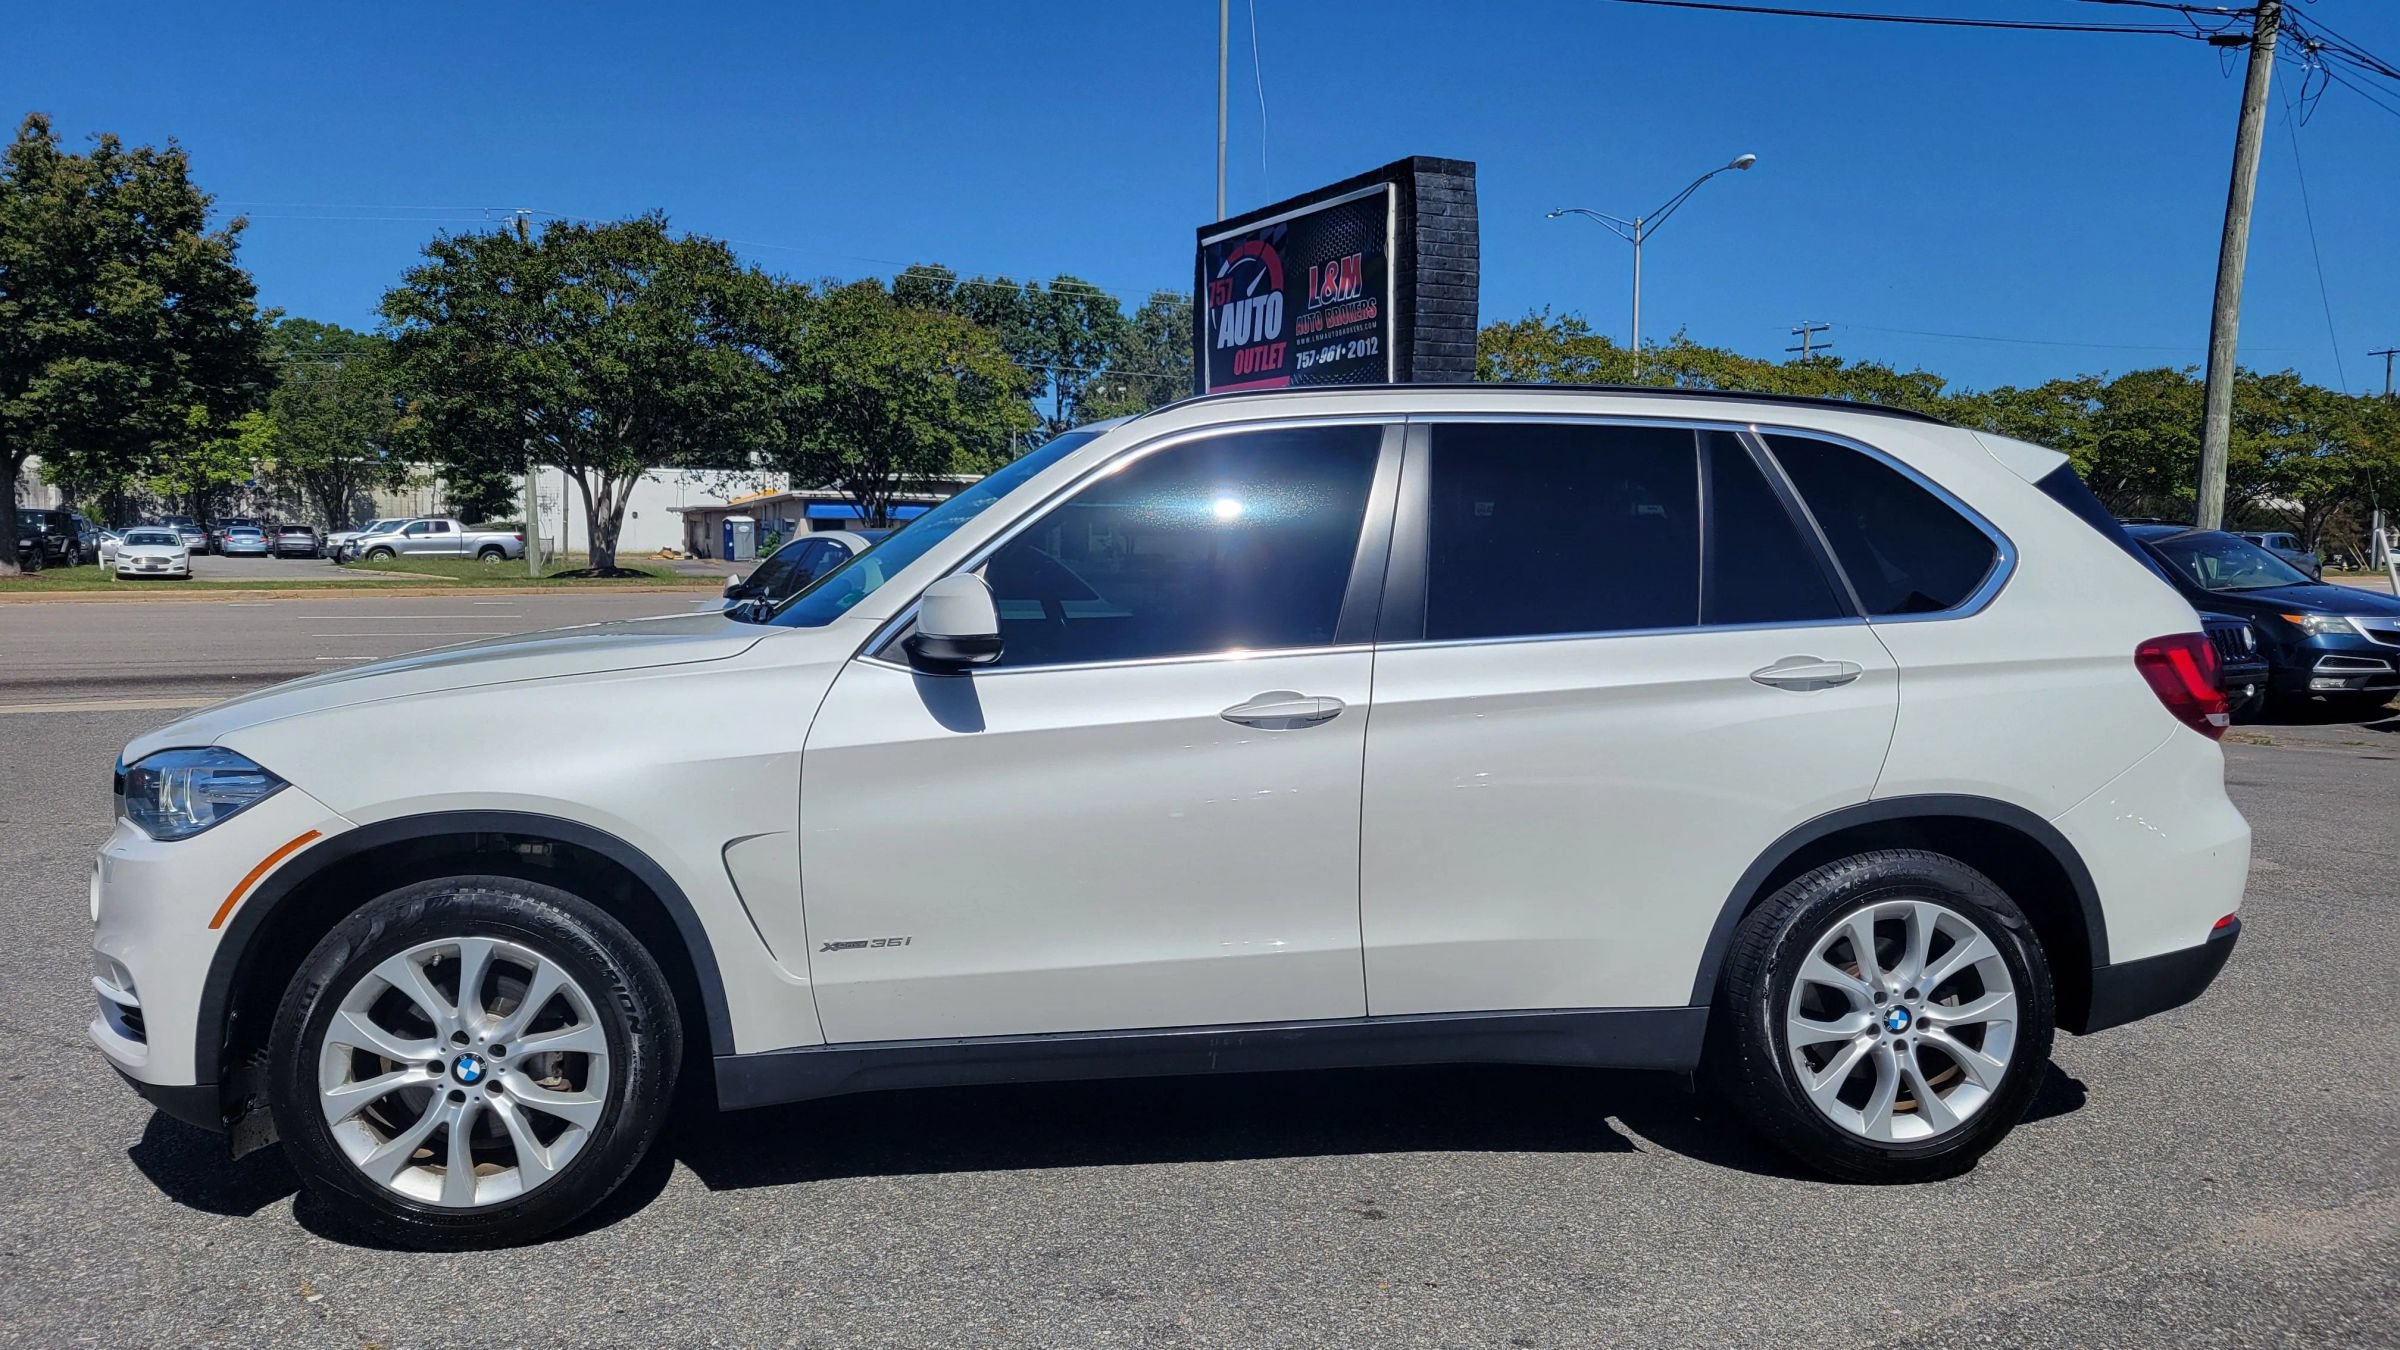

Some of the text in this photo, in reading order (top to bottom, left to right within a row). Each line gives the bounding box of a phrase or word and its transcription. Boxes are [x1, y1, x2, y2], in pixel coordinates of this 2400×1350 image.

[1208, 278, 1233, 308] 757
[1308, 252, 1362, 310] L&M
[1216, 291, 1284, 349] AUTO
[1296, 297, 1377, 337] AUTO BROKERS
[1233, 341, 1288, 376] OUTLET
